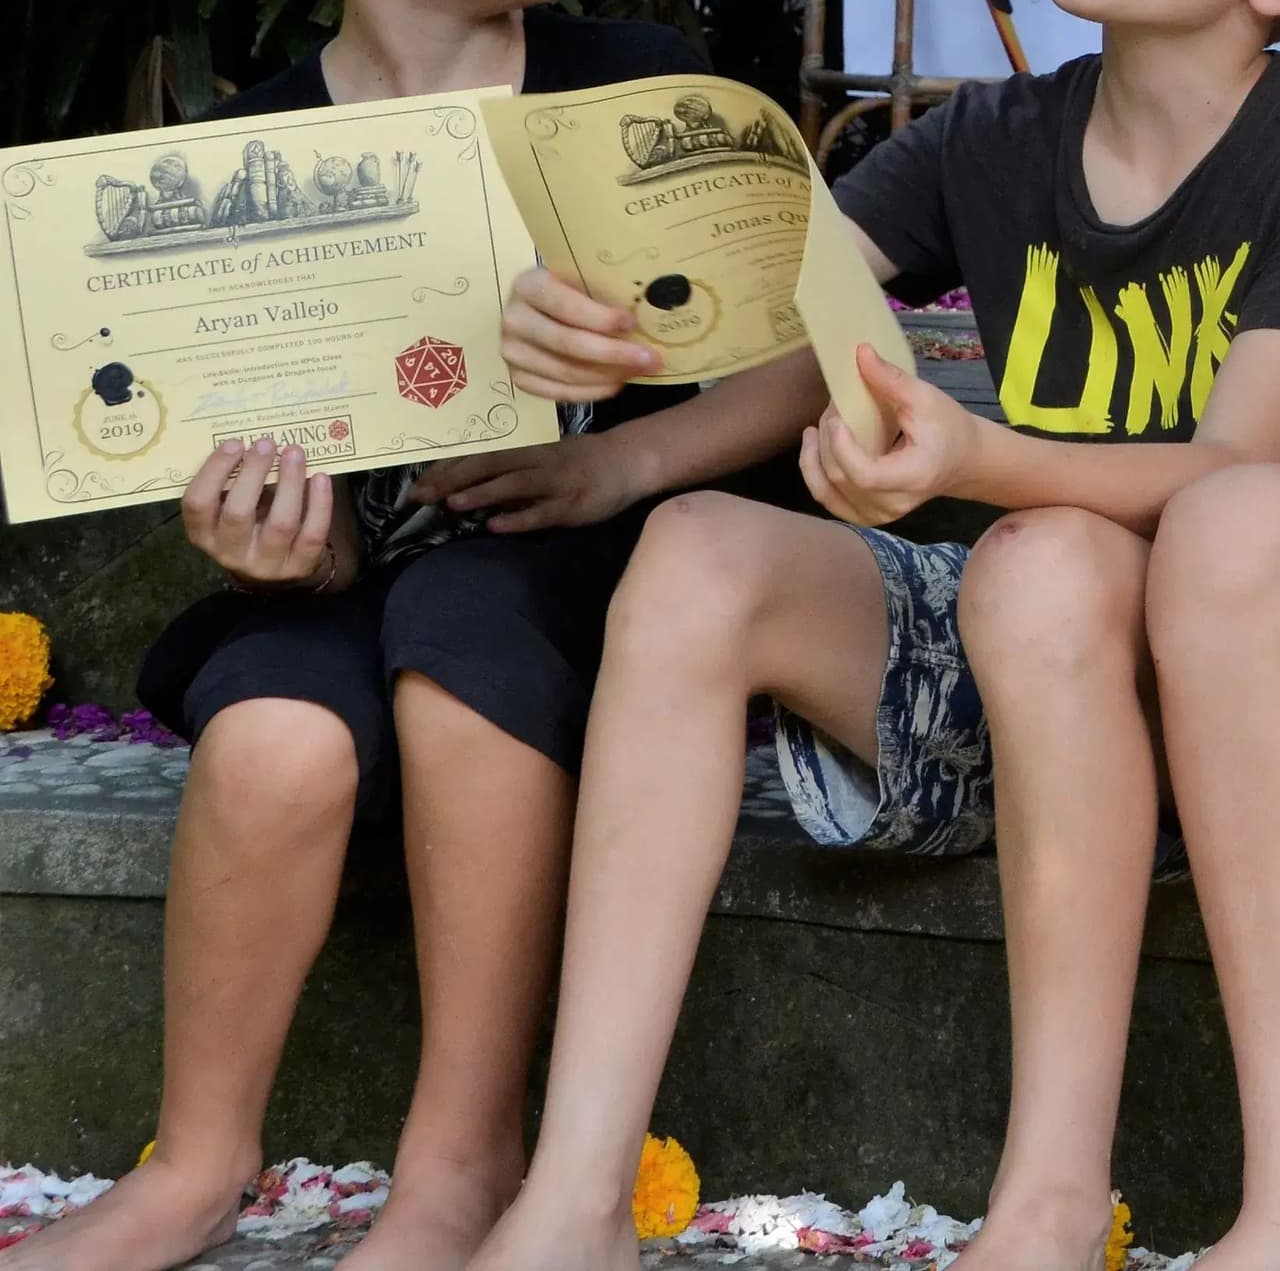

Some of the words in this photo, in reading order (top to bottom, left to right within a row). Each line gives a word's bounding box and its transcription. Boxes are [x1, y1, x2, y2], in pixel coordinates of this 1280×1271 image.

[624, 173, 772, 216] CERTIFICATE
[775, 177, 792, 190] of
[710, 214, 772, 239] Jonas
[86, 257, 235, 293] CERTIFICATE
[241, 252, 262, 274] of
[265, 231, 427, 268] ACHIEVEMENT
[195, 312, 258, 335] Aryan
[264, 299, 339, 323] Vallejo
[100, 422, 144, 440] 2019
